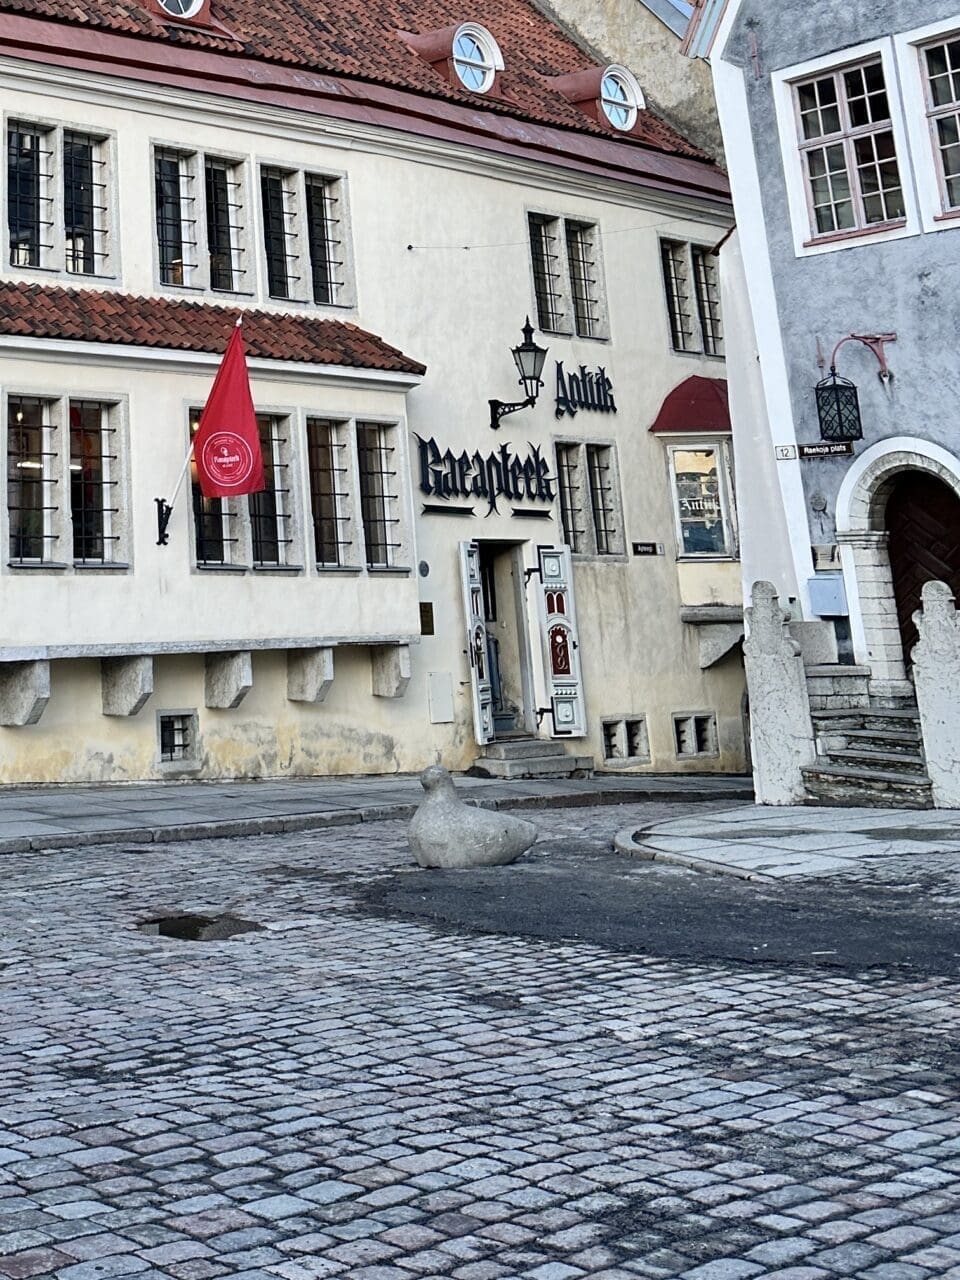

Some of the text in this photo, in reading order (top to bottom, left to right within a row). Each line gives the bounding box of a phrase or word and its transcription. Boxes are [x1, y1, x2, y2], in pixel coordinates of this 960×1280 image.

[555, 360, 617, 419] Antiik
[780, 447, 790, 458] 12
[803, 444, 847, 455] Raekoja plats
[412, 432, 558, 518] Raeapteek
